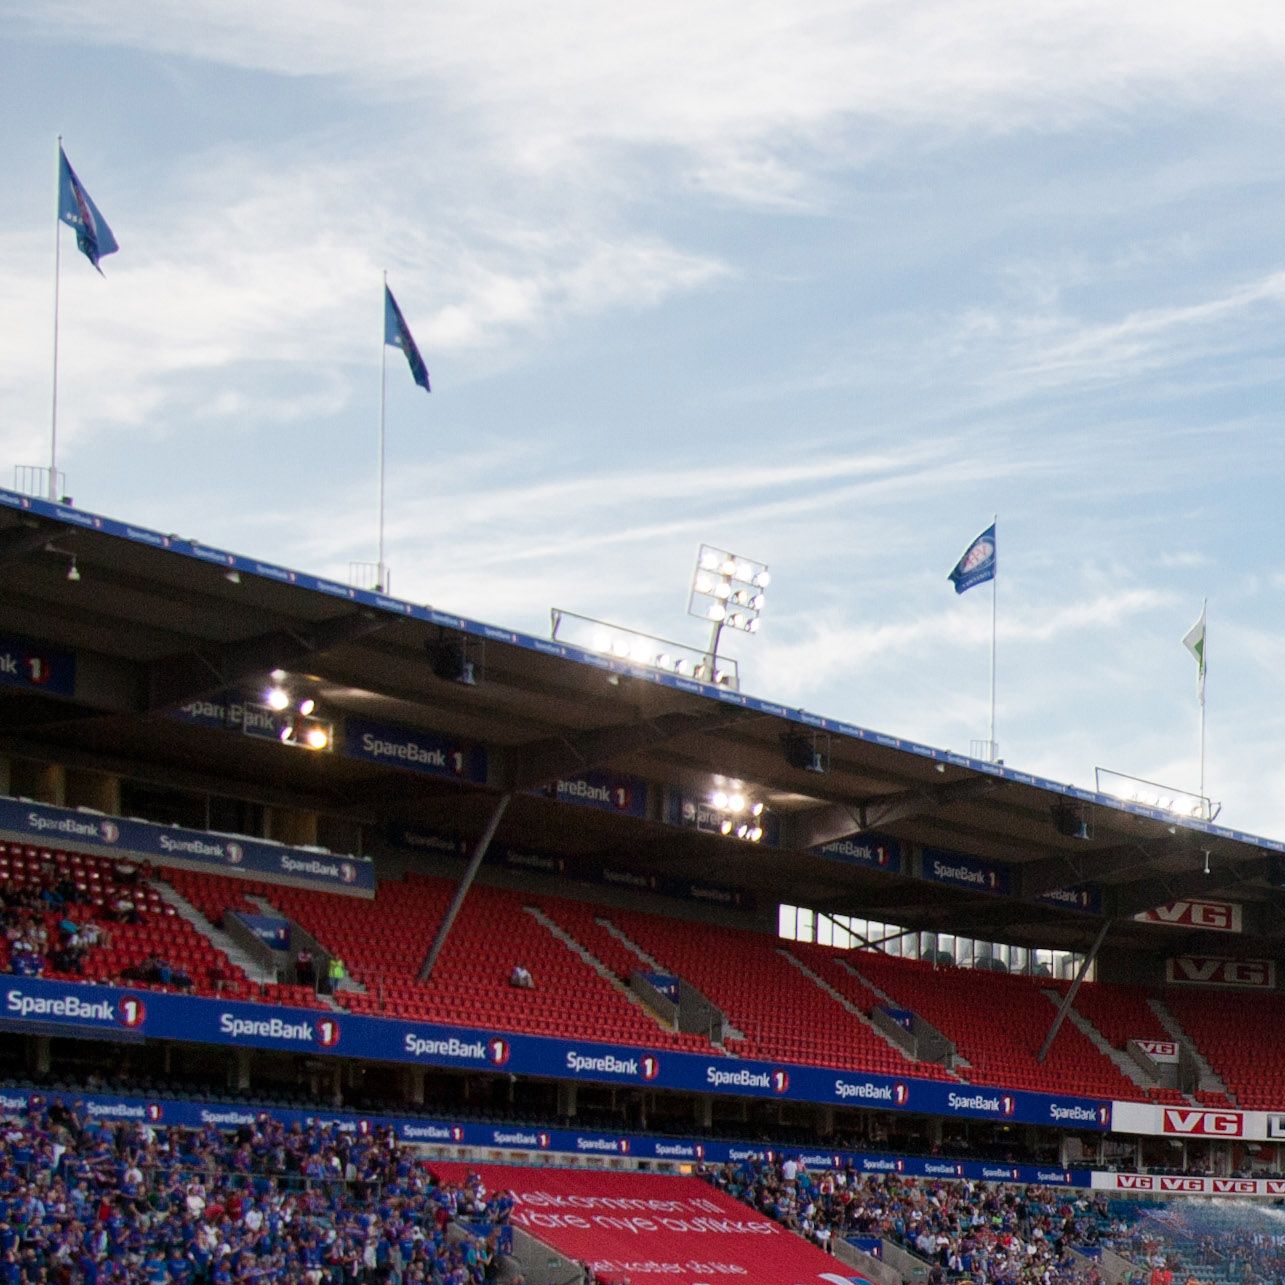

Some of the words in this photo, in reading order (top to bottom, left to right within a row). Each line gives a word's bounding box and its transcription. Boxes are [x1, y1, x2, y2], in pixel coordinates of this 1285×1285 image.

[362, 733, 445, 766] SpareBank
[453, 752, 462, 770] 1
[29, 813, 98, 837] SpareBank
[160, 836, 223, 857] SpareBank
[281, 856, 338, 877] SpareBank
[934, 861, 984, 885] SpareBank
[8, 991, 114, 1020] SpareBank
[125, 1001, 137, 1024] 1
[220, 1013, 312, 1041] SpareBank
[322, 1023, 332, 1043] 1
[405, 1034, 485, 1059] SpareBank
[493, 1042, 503, 1061] 1
[567, 1052, 637, 1075] SpareBank
[645, 1058, 653, 1076] 1
[707, 1067, 770, 1088] SpareBank
[774, 1073, 785, 1090] 1
[835, 1080, 891, 1100] SpareBank
[896, 1086, 905, 1101] 1
[87, 1103, 145, 1119] SpareBank
[150, 1106, 159, 1118] 1
[949, 1093, 999, 1111] SpareBank
[1003, 1098, 1012, 1113] 1
[1050, 1104, 1097, 1122] SpareBank
[1100, 1108, 1107, 1122] 1
[404, 1125, 450, 1138] SpareBank
[452, 1128, 460, 1139] 1
[1167, 1110, 1240, 1135] VG
[494, 1131, 536, 1145] SpareBank
[540, 1135, 547, 1145] 1
[577, 1138, 617, 1151] SpareBank
[620, 1141, 626, 1151] 1
[655, 1144, 693, 1156] SpareBank
[696, 1146, 702, 1158] 1
[864, 1159, 895, 1171] SpareBank
[897, 1160, 903, 1171] 1
[1162, 1178, 1202, 1190] VG
[597, 1217, 657, 1233] nye
[660, 1213, 779, 1235] butikker
